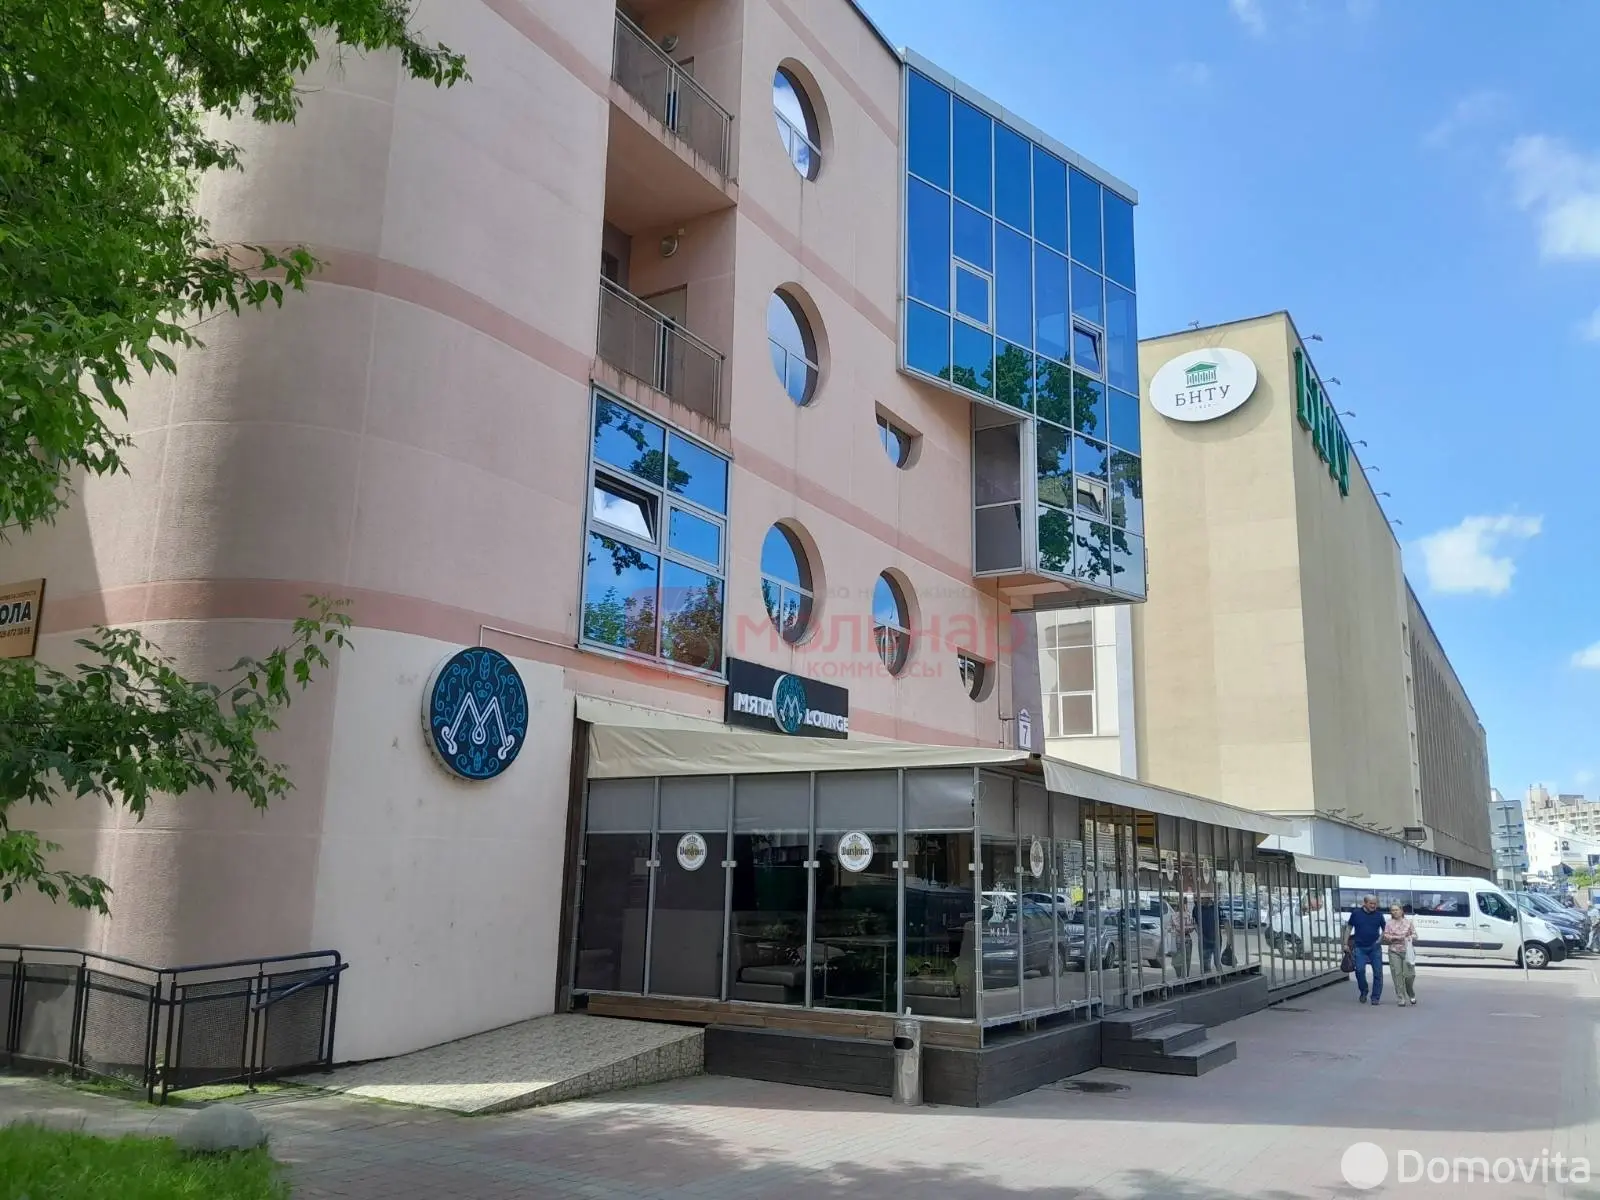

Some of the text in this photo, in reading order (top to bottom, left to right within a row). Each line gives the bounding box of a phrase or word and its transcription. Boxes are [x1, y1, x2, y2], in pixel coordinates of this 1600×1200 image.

[1175, 385, 1231, 406] БНТУ
[733, 692, 775, 718] МЯТА
[804, 708, 849, 733] LOUNGE
[1022, 724, 1029, 745] 7
